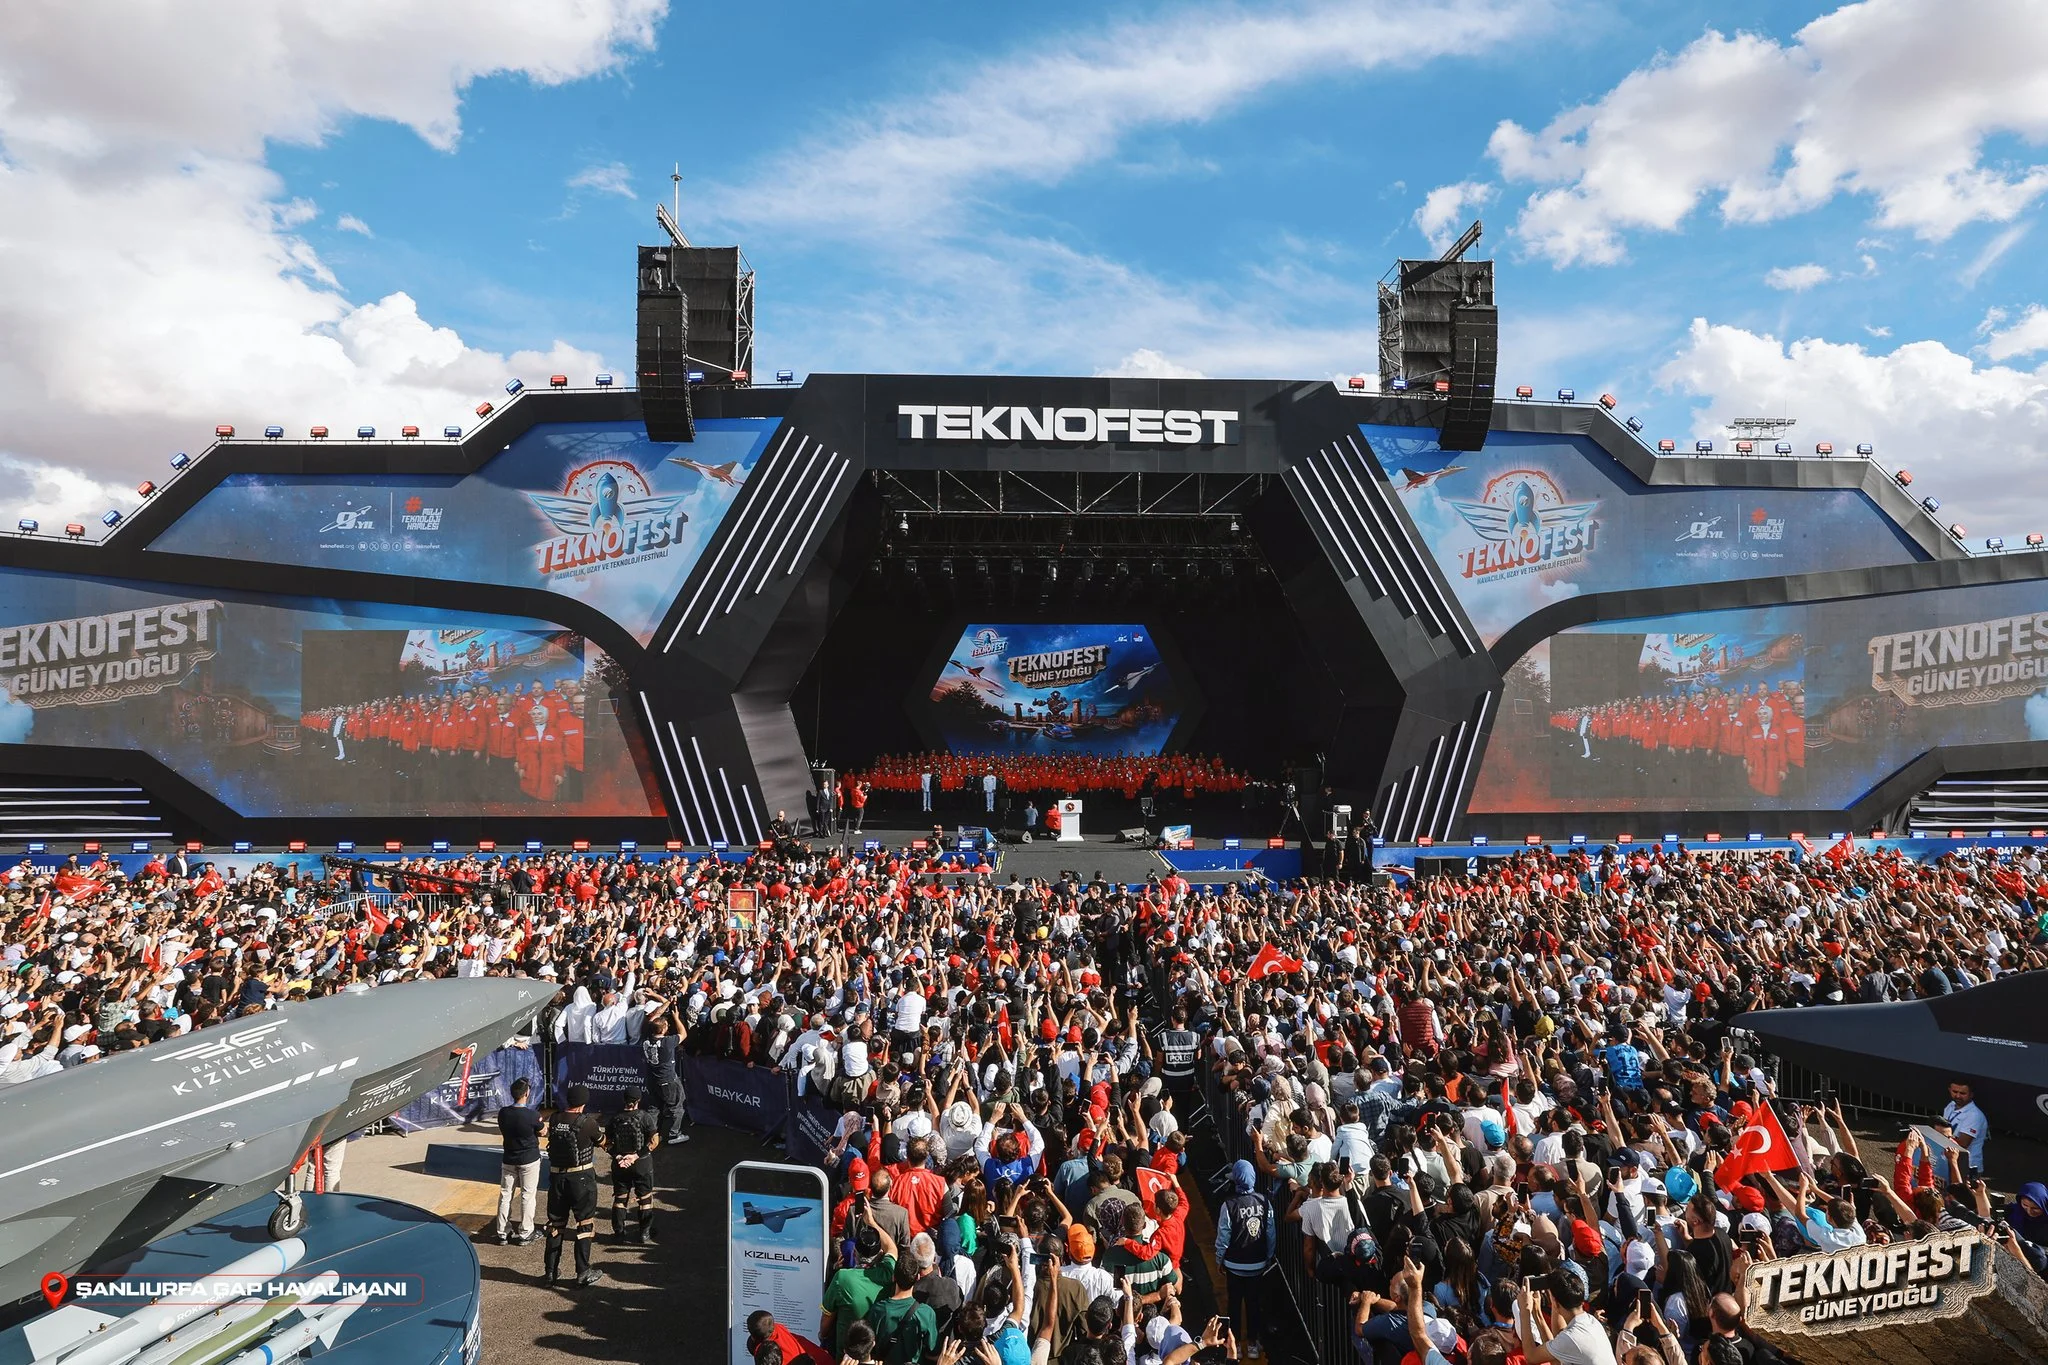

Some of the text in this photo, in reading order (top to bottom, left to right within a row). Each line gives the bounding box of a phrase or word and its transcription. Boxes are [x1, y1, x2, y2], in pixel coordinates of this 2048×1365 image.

[898, 404, 1239, 444] TEKNOFEST
[320, 543, 354, 551] teknofest.org
[536, 512, 688, 574] TEKNOFEST
[1458, 519, 1600, 578] TEKNOFEST
[586, 564, 602, 574] UZAY
[602, 563, 610, 571] VE
[610, 555, 641, 569] TEKNOLOJİ
[640, 549, 669, 563] FESTİVALİ
[1520, 568, 1528, 576] VE
[970, 641, 1008, 658] TEKNOFEST
[1007, 645, 1107, 673] TEKNOFEST
[12, 651, 180, 696] GÜNEYDOĞU
[1025, 665, 1092, 683] GÜNEYDOĞU
[1907, 656, 2048, 696] GÜNEYDOĞU
[191, 1039, 284, 1073] BAYRAKTAR
[171, 1041, 315, 1096] KIZILELMA
[587, 1073, 645, 1083] MİLLİ VE ÖZGÜN
[592, 1065, 638, 1074] TÜRKİYE'NİN
[346, 1086, 412, 1118] KIZILELMA
[363, 1084, 406, 1104] BAYRAKTAR
[430, 1089, 502, 1105] KIZIELMA
[713, 1086, 761, 1107] BAYKAR
[744, 1250, 810, 1264] KIZILELMA
